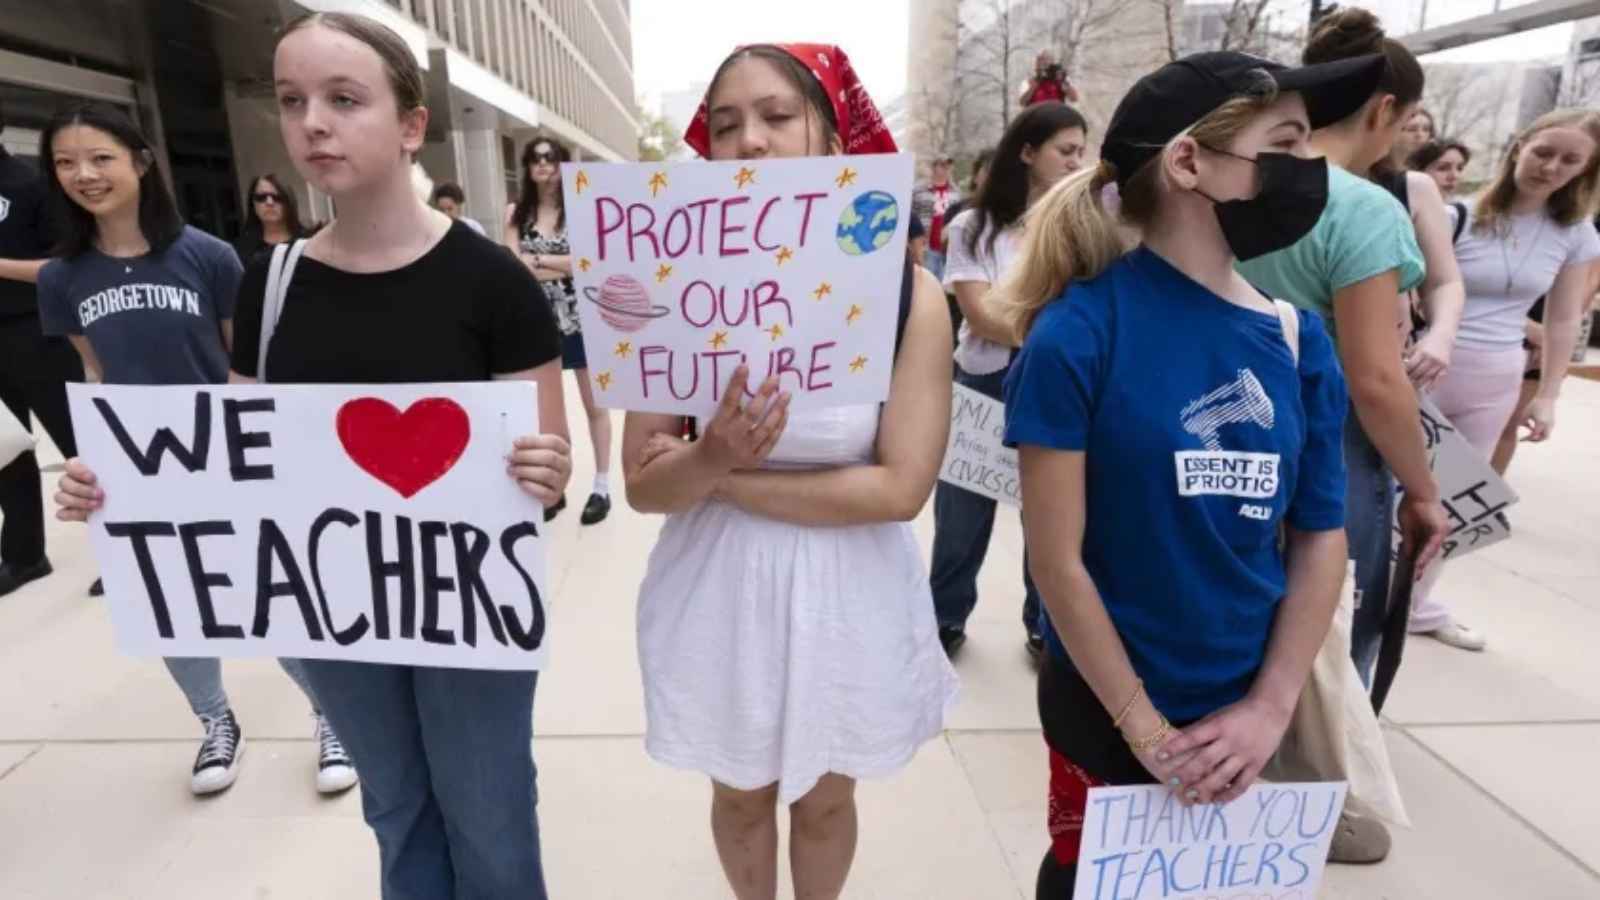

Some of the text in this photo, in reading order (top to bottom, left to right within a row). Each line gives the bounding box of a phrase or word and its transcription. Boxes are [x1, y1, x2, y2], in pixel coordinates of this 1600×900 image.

[595, 193, 828, 262] PROTECT
[78, 283, 202, 328] GEORGETOWN
[681, 280, 793, 328] OUR
[639, 342, 837, 401] FUTURE
[92, 391, 276, 482] WE
[1258, 460, 1273, 475] IS
[104, 507, 546, 651] TEACHERS
[1093, 788, 1336, 848] THANK YOU
[1092, 842, 1319, 900] TEACHERS
